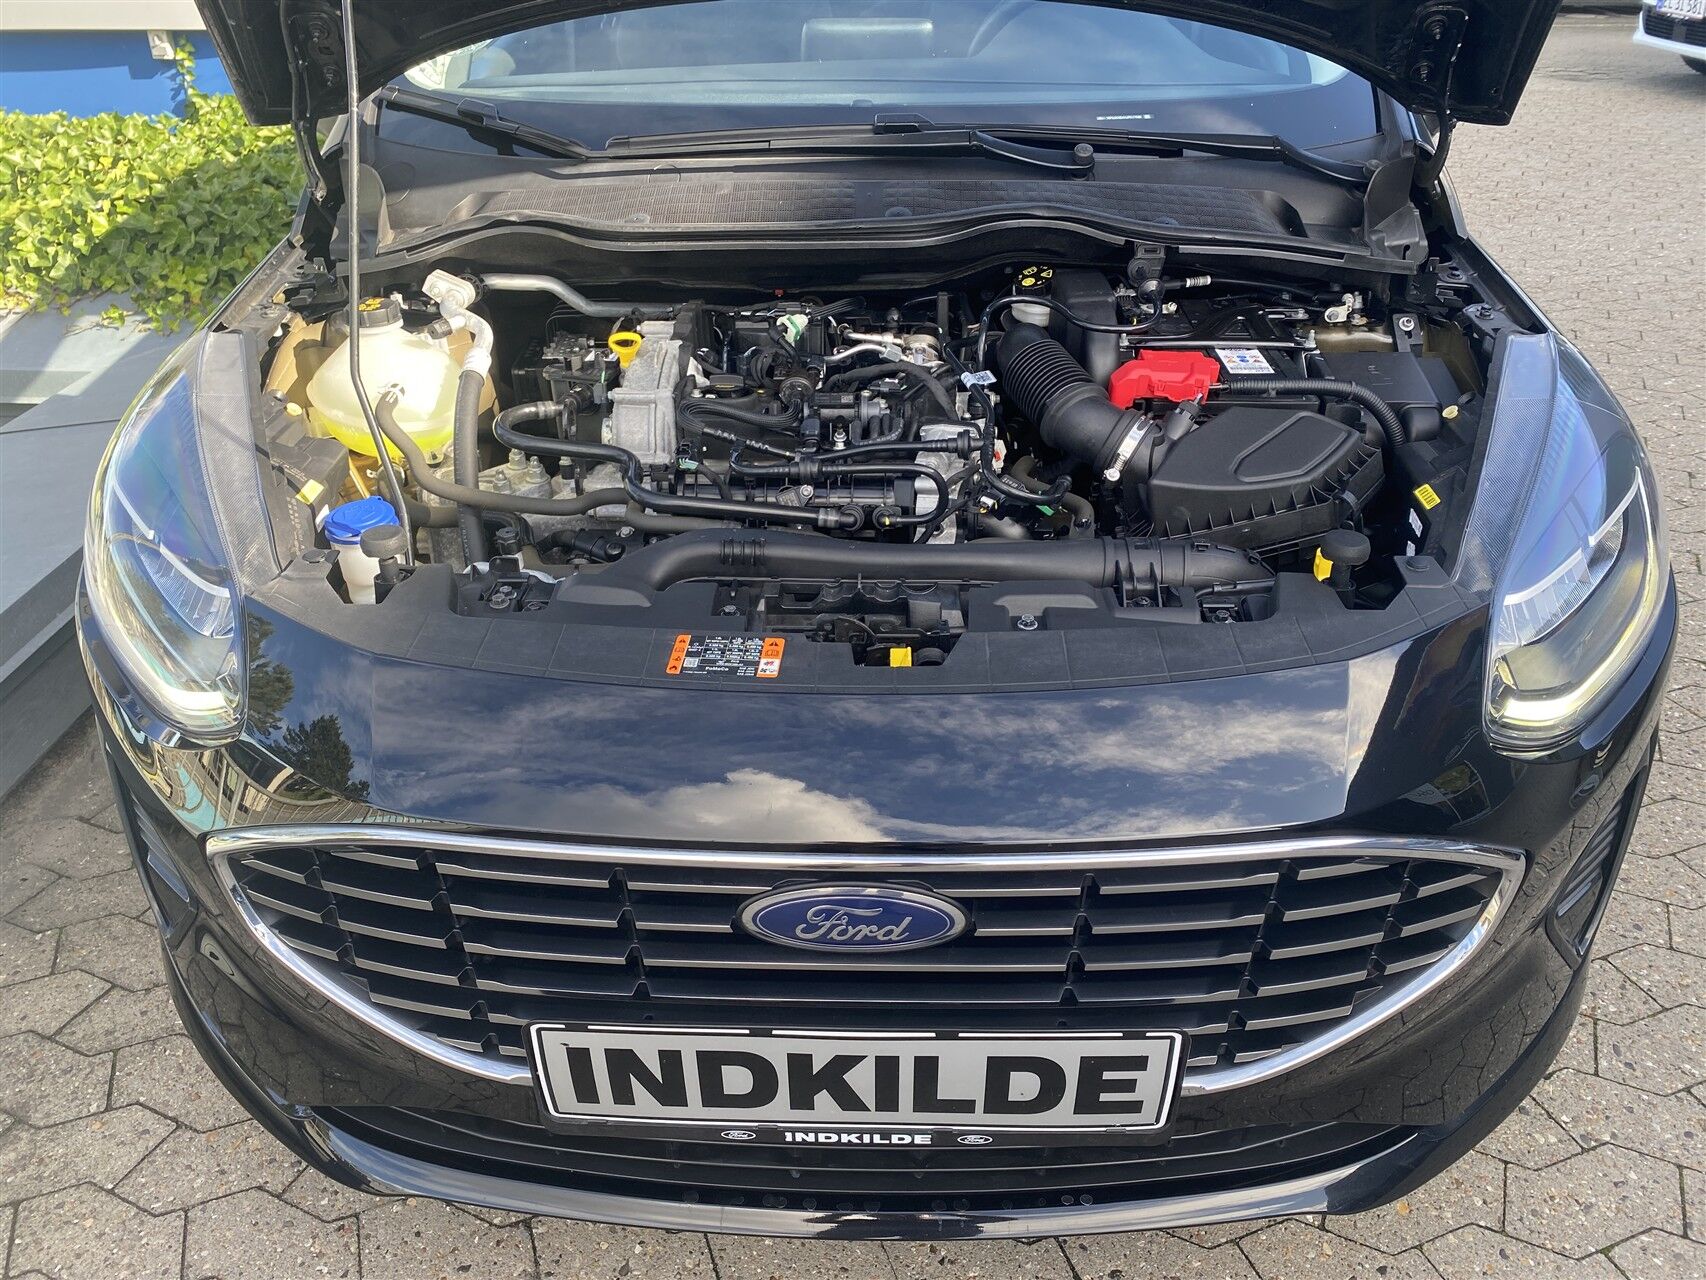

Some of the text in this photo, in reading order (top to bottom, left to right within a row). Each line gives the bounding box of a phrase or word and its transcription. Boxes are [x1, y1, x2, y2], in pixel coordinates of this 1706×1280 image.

[795, 905, 913, 941] Ford
[565, 1047, 1149, 1115] INDKILDE
[785, 1132, 932, 1144] INDKILDE
